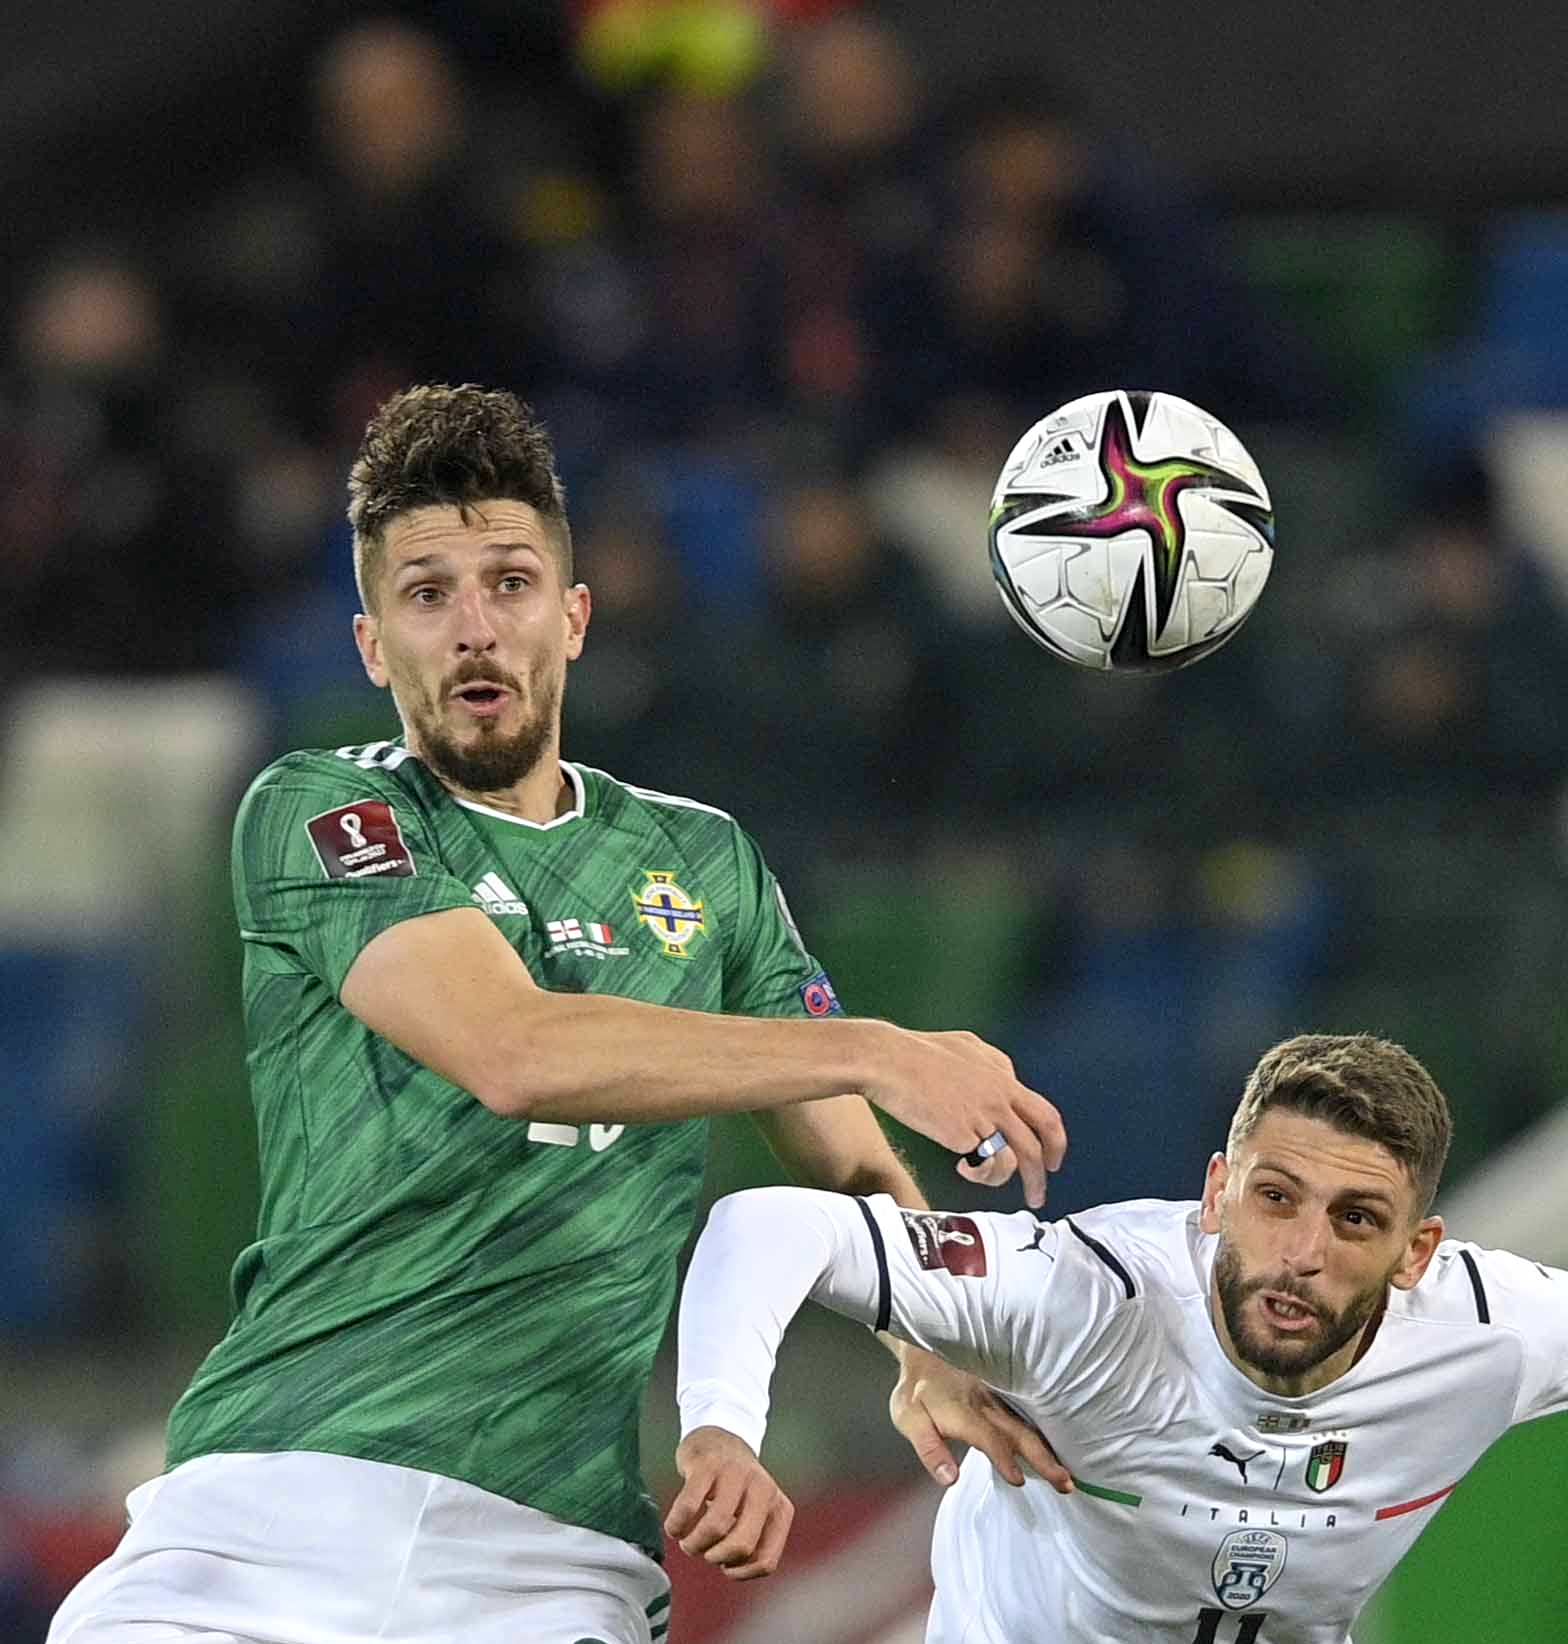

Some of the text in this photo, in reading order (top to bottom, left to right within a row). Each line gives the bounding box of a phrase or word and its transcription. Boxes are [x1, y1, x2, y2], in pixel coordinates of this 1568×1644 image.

[1040, 453, 1080, 469] adidas
[1182, 1504, 1336, 1528] ITALIA
[1231, 1545, 1277, 1553] EUROPEAN
[1226, 1591, 1251, 1600] 2020
